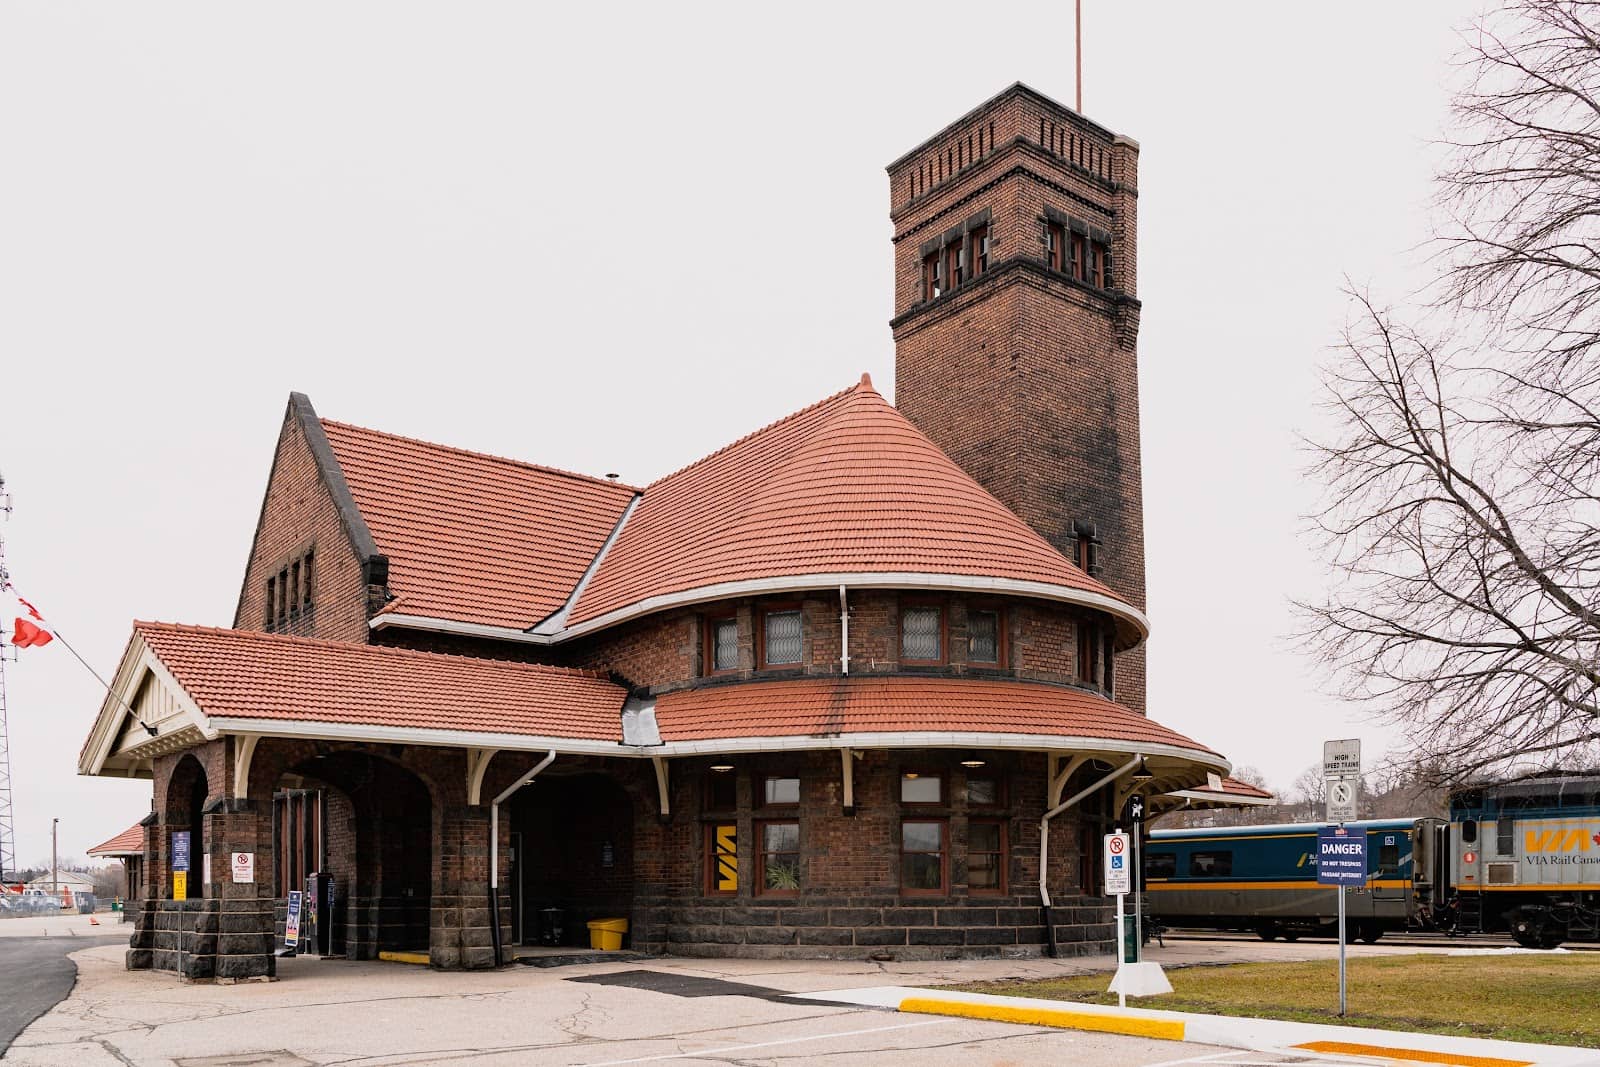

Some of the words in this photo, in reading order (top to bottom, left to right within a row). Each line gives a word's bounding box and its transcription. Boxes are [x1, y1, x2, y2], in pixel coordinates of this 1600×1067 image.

[1525, 829, 1590, 852] VIA
[1321, 843, 1363, 855] DANGER
[1526, 856, 1548, 865] VIA
[1550, 855, 1571, 865] Rail
[1572, 854, 1600, 865] Cana
